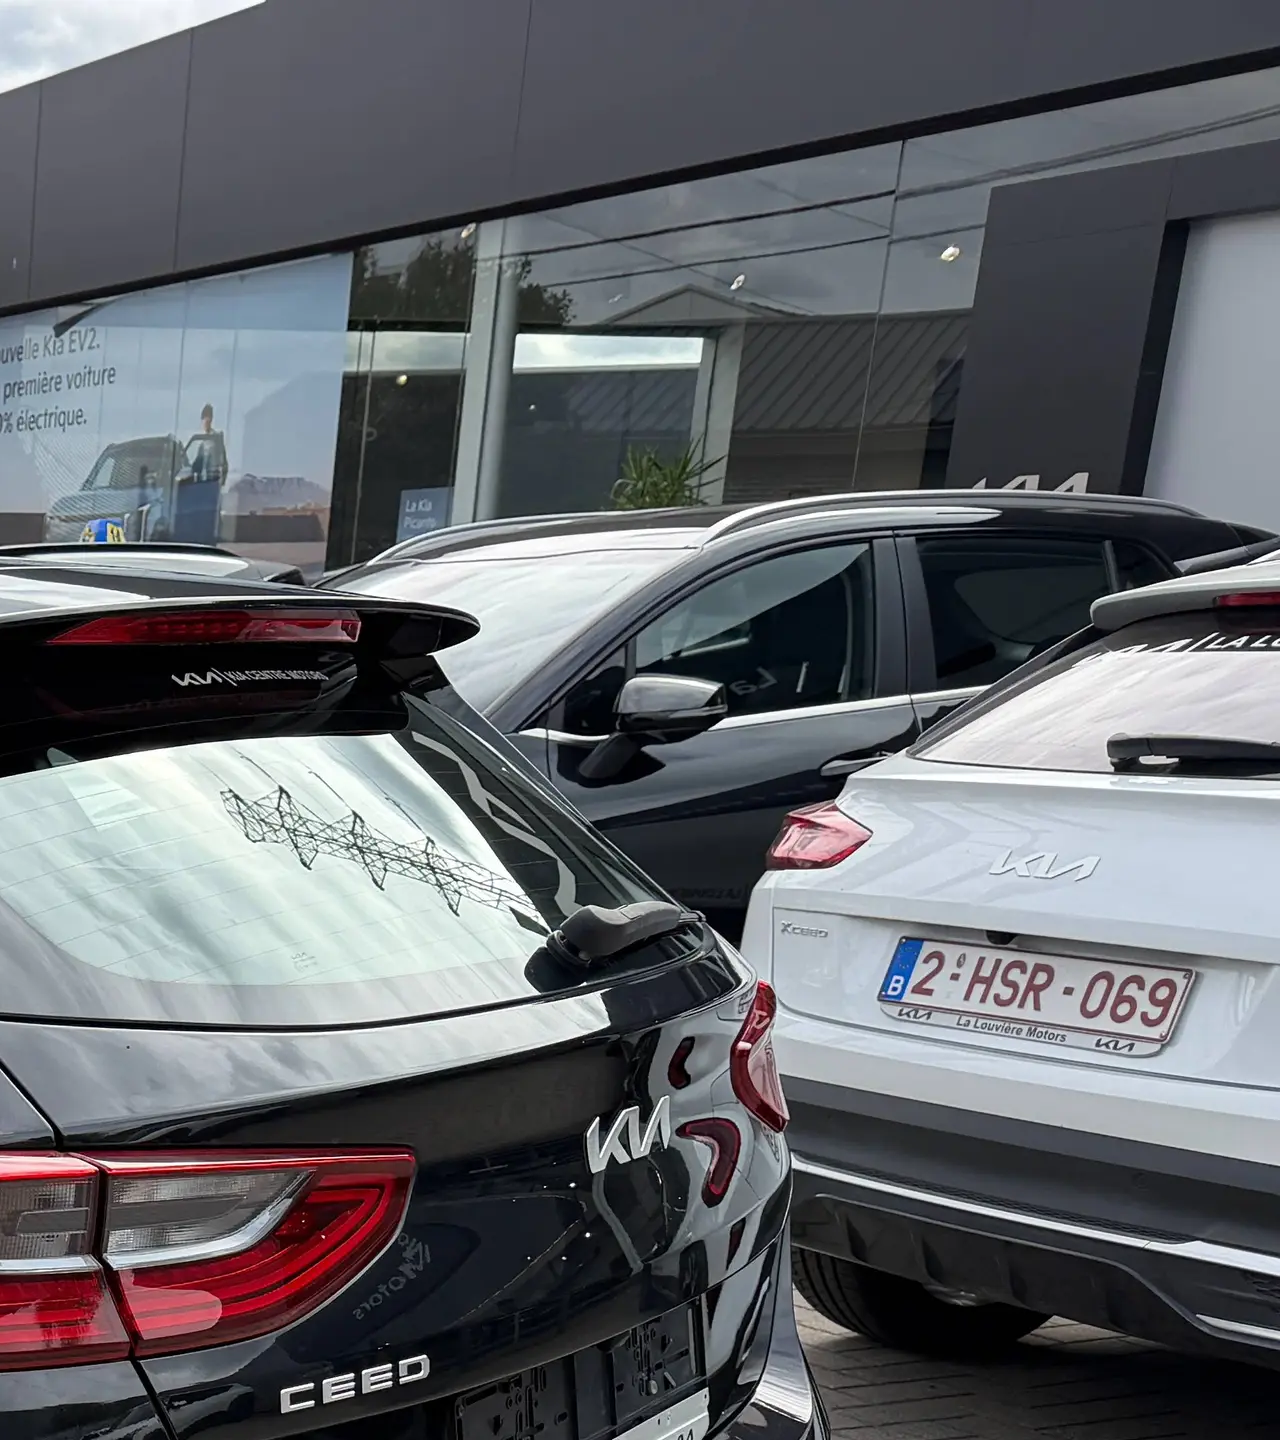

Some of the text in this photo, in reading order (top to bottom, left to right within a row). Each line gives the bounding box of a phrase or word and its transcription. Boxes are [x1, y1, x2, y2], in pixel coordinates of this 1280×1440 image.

[43, 334, 64, 358] Kia
[68, 327, 100, 354] EV2.
[3, 371, 63, 405] première
[66, 365, 116, 390] voiture
[16, 405, 87, 433] électrique.
[171, 671, 223, 687] KIA
[988, 848, 1102, 883] KIA
[887, 975, 905, 996] B
[898, 1007, 1136, 1053] KIA La Louvière Motors KIA
[586, 1094, 671, 1174] KIA
[280, 1354, 431, 1414] CEED
